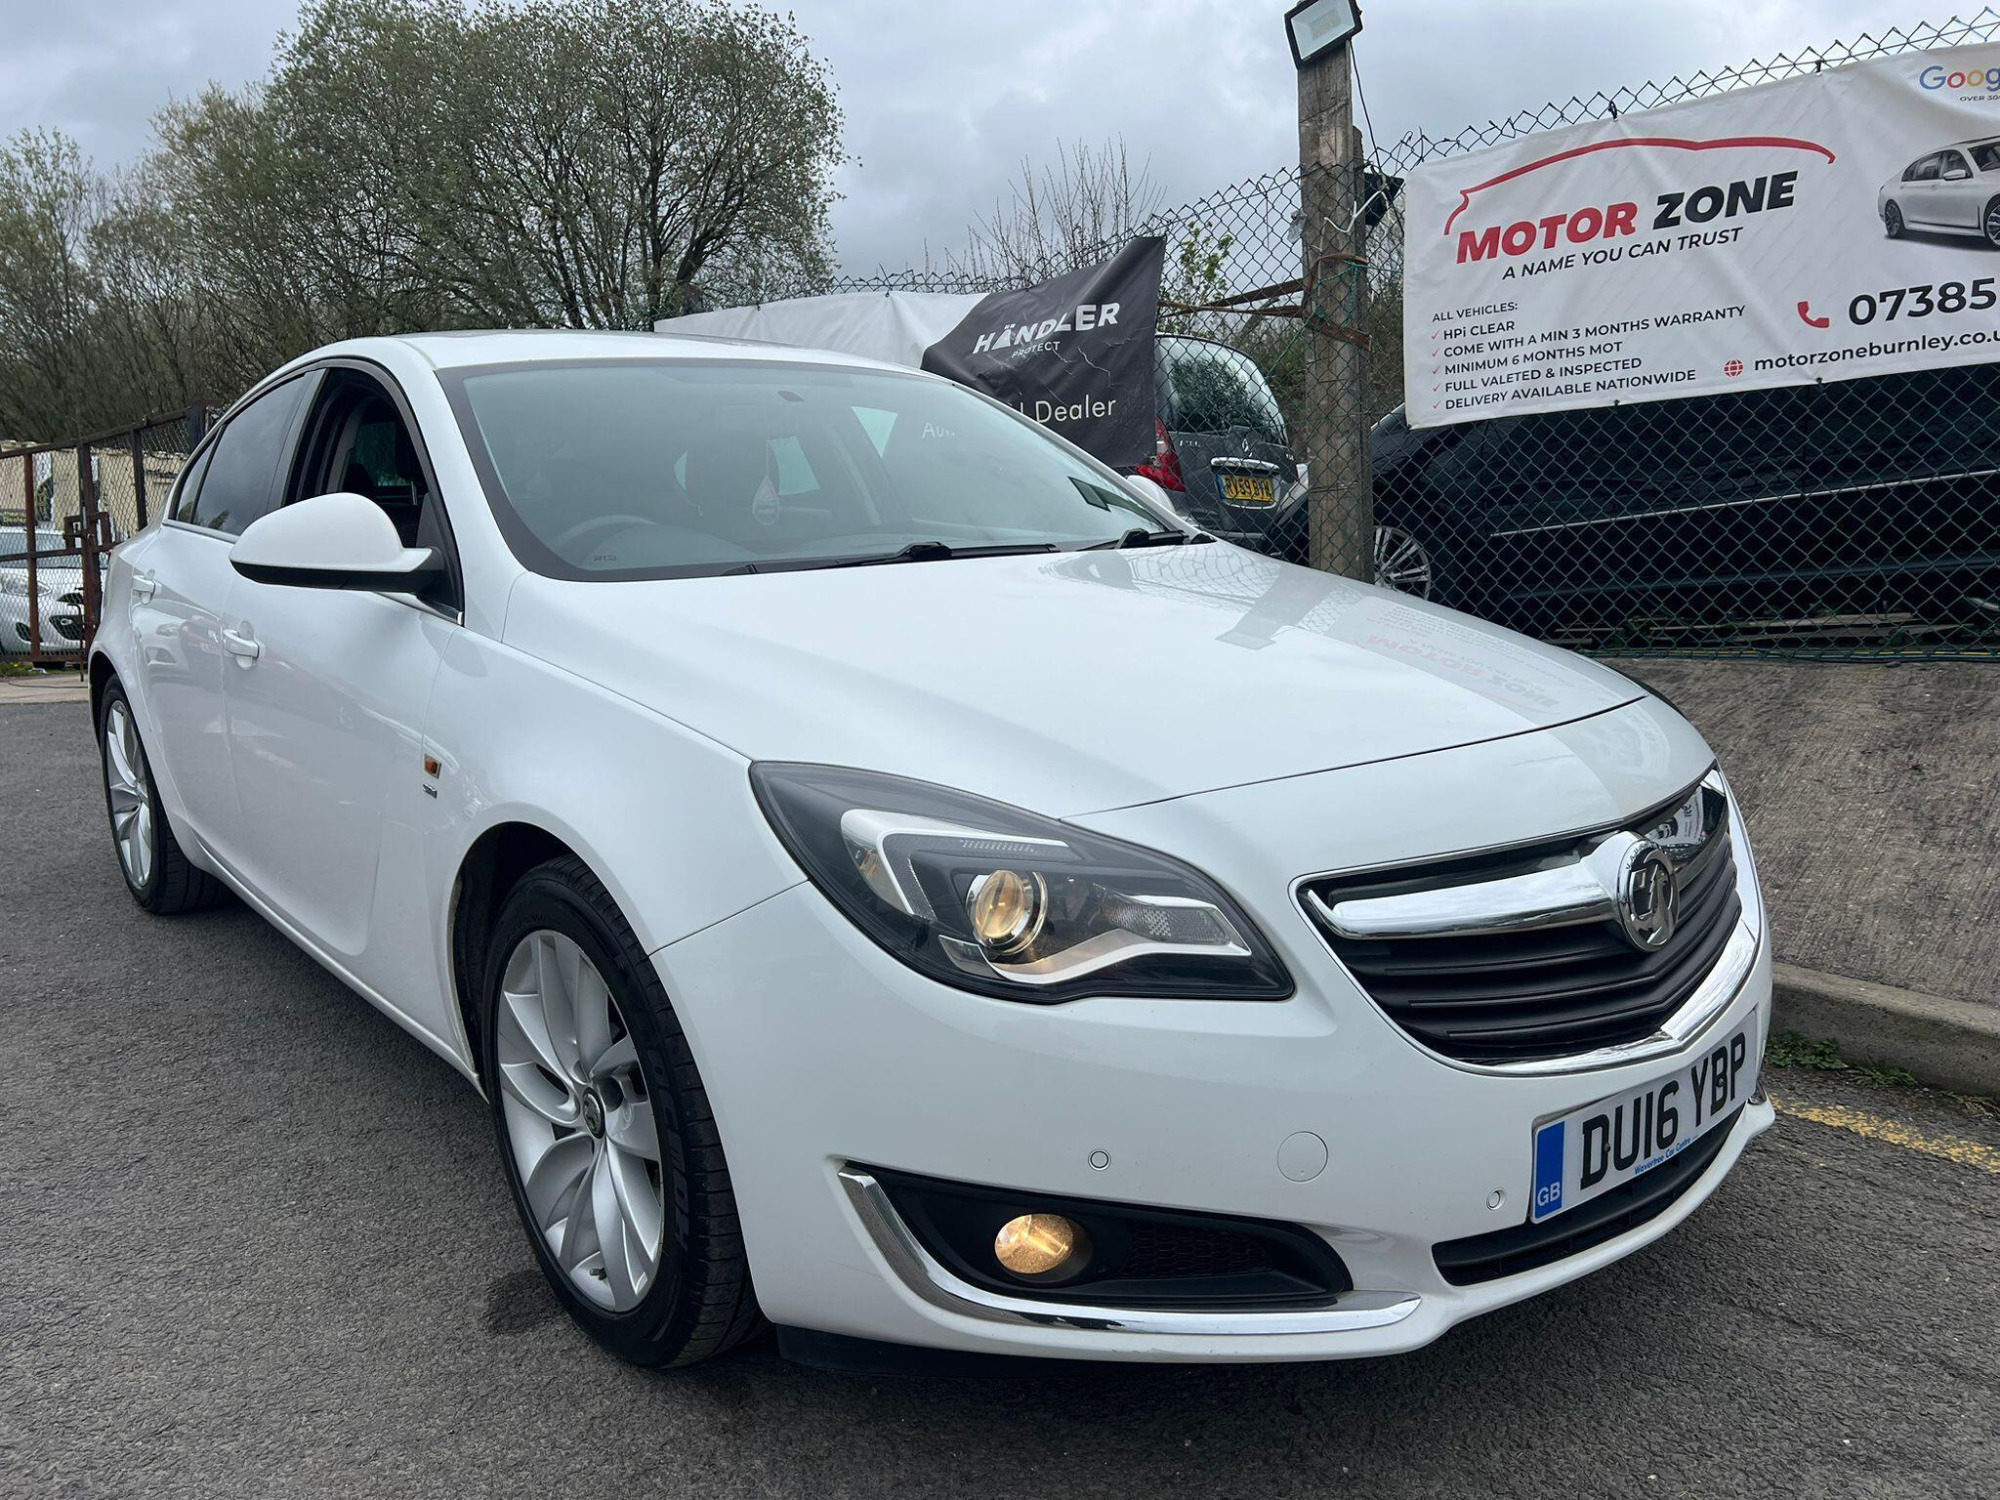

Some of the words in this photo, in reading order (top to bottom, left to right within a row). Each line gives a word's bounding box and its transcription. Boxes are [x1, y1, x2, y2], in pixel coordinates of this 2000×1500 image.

[1919, 65, 2000, 92] Goog
[1457, 202, 1638, 264] MOTOR
[1653, 171, 1798, 230] ZONE
[1502, 266, 1515, 280] A
[1521, 254, 1576, 277] NAME
[1581, 247, 1622, 266] YOU
[1628, 239, 1671, 258] CAN
[1677, 227, 1743, 250] TRUST
[1432, 313, 1453, 322] ALL
[1456, 302, 1518, 318] VEHICLES:
[1849, 278, 1997, 326] 07385
[972, 302, 1121, 354] HÄNDLER
[1443, 326, 1466, 340] HPi
[1470, 321, 1515, 336] CLEAR
[1444, 343, 1484, 358] COME
[1488, 337, 1524, 351] WITH
[1528, 335, 1537, 345] A
[1541, 330, 1568, 343] MIN
[1572, 328, 1581, 339] 3
[1585, 318, 1650, 337] MONTHS
[1654, 305, 1746, 328] WARRANTY
[1011, 341, 1061, 358] PROTECT
[1445, 357, 1508, 375] MINIMUM
[1512, 355, 1519, 365] 6
[1523, 346, 1585, 363] MONTHS
[1590, 341, 1623, 355] MOT
[1445, 379, 1477, 392] FULL
[1481, 369, 1541, 387] VALETED
[1545, 367, 1555, 379] &
[1560, 358, 1642, 377] INSPECTED
[1445, 391, 1508, 410] DELIVERY
[1511, 382, 1592, 400] AVAILABLE
[1596, 369, 1696, 391] NATIONWIDE
[1035, 394, 1116, 423] Dealer
[1580, 1080, 1679, 1190] DU16
[1691, 1032, 1746, 1128] YBP
[1537, 1181, 1561, 1208] GB
